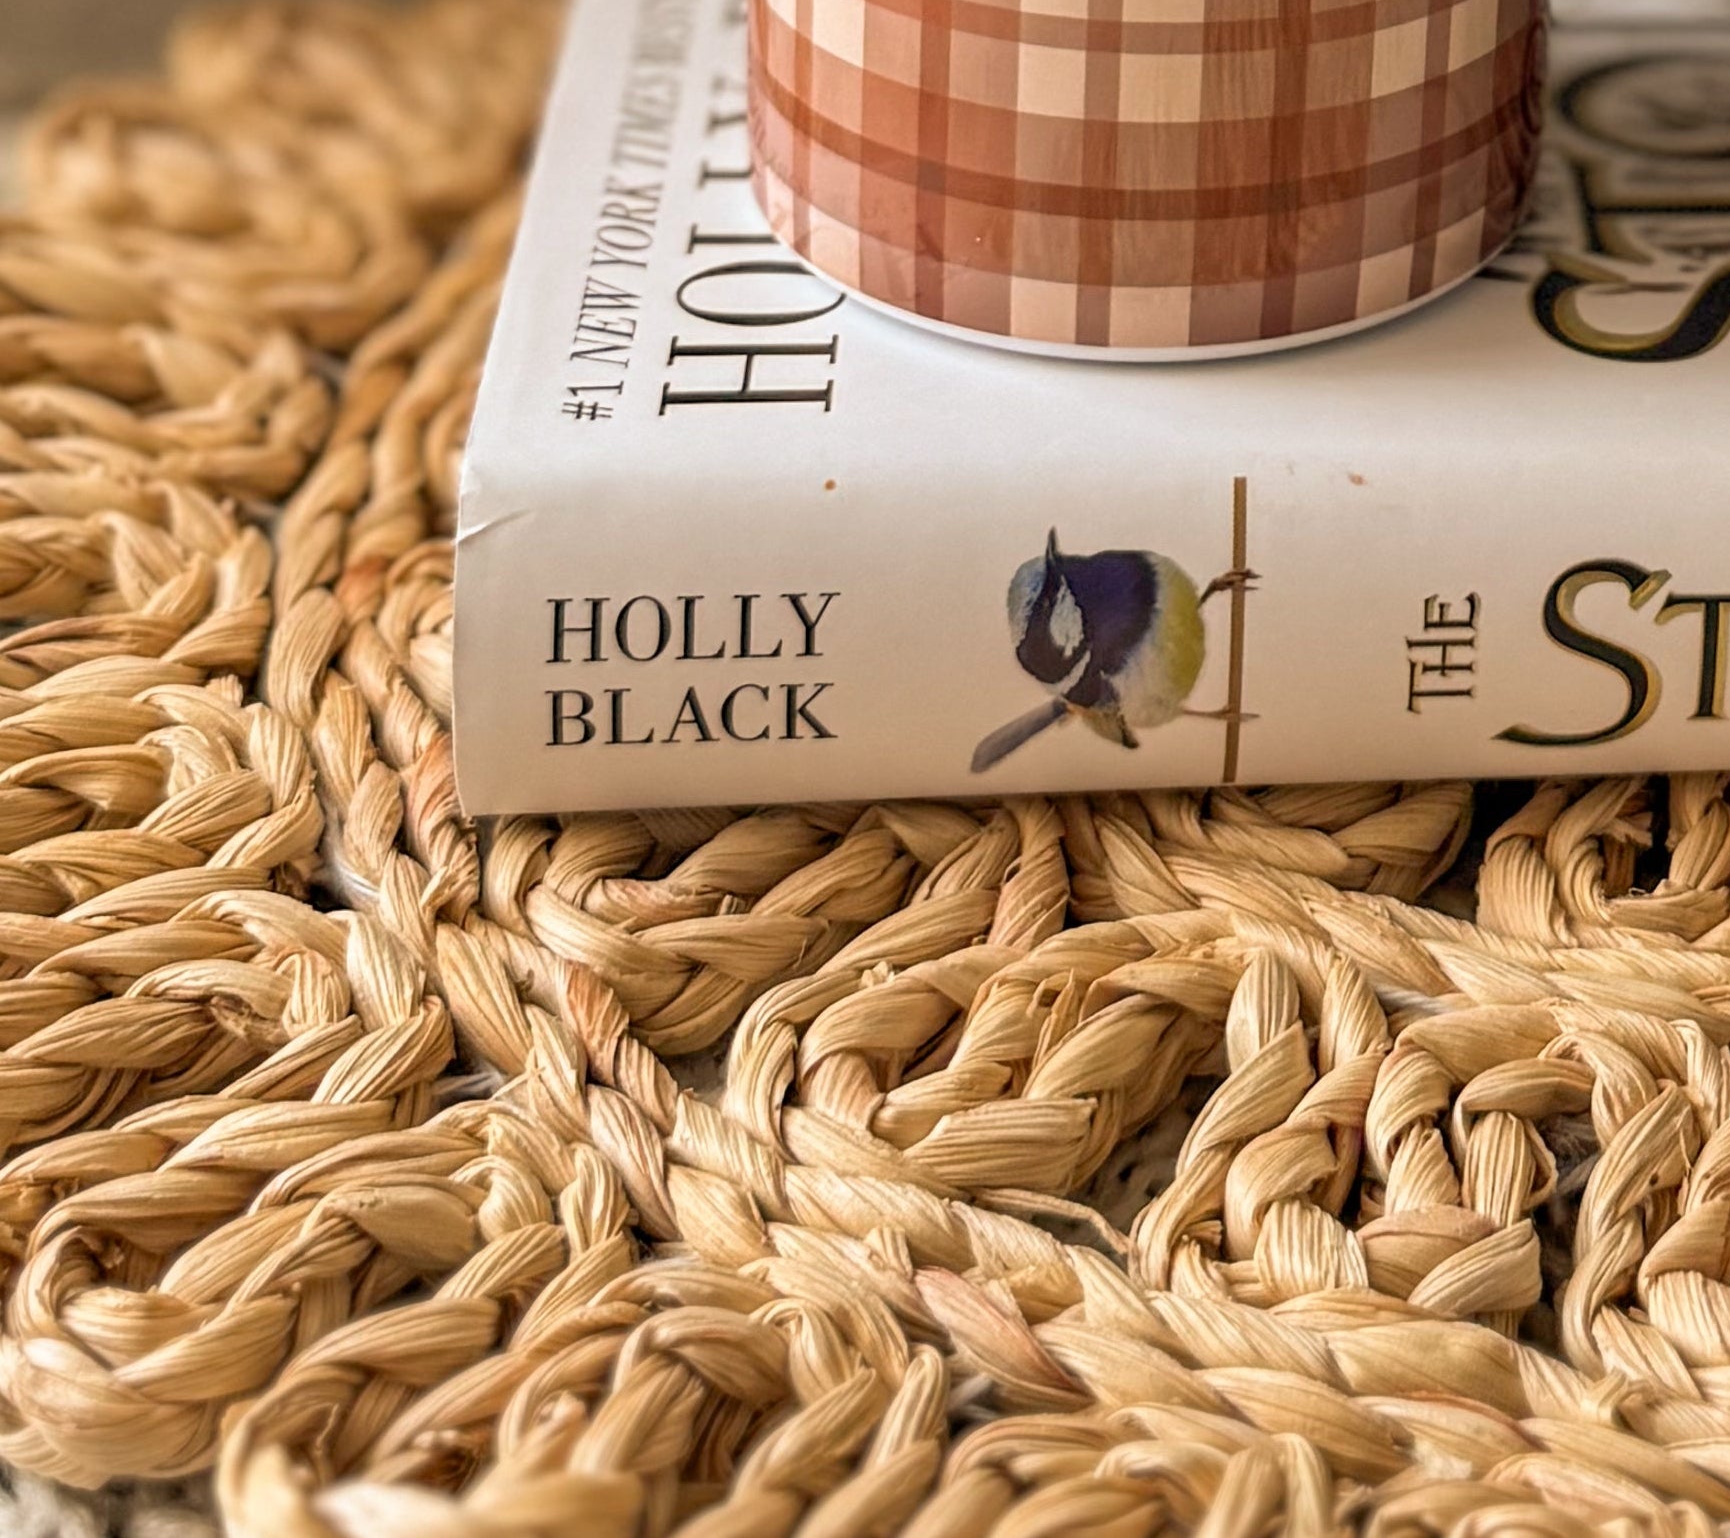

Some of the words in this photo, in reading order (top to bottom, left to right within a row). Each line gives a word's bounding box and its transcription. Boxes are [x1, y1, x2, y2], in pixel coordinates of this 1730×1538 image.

[611, 73, 683, 169] TIMES
[589, 174, 664, 269] YORK
[570, 275, 642, 370] NEW
[561, 380, 626, 422] #1
[545, 592, 841, 665] HOLLY
[1405, 591, 1481, 715] THE
[545, 682, 839, 748] BLACK
